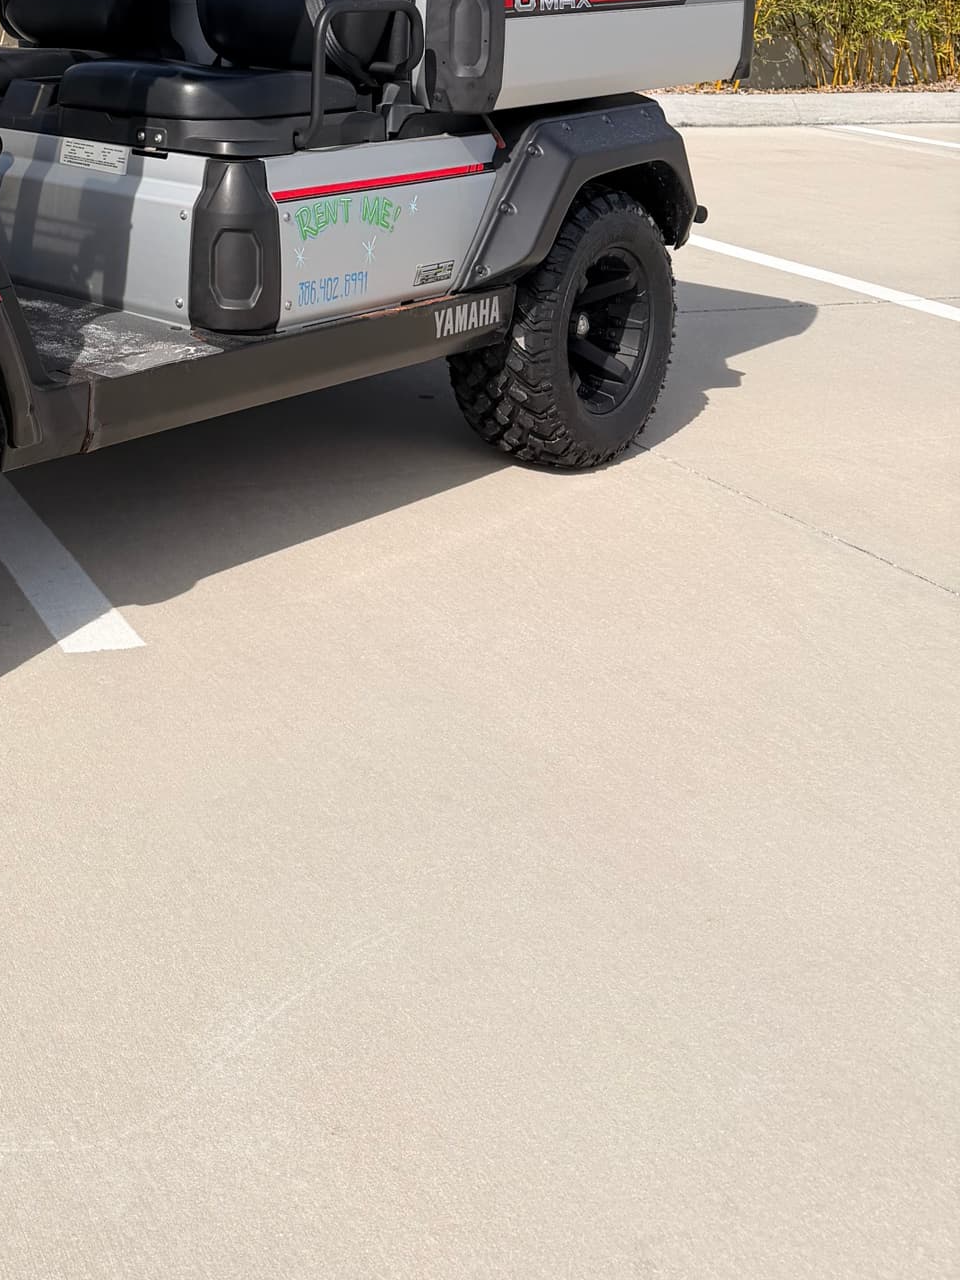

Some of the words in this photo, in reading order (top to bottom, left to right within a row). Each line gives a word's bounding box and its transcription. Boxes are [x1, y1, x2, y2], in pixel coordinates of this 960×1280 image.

[294, 198, 352, 241] RENT
[360, 195, 402, 233] ME!
[297, 271, 369, 307] 386.402.8991
[434, 295, 500, 338] YAMAHA
